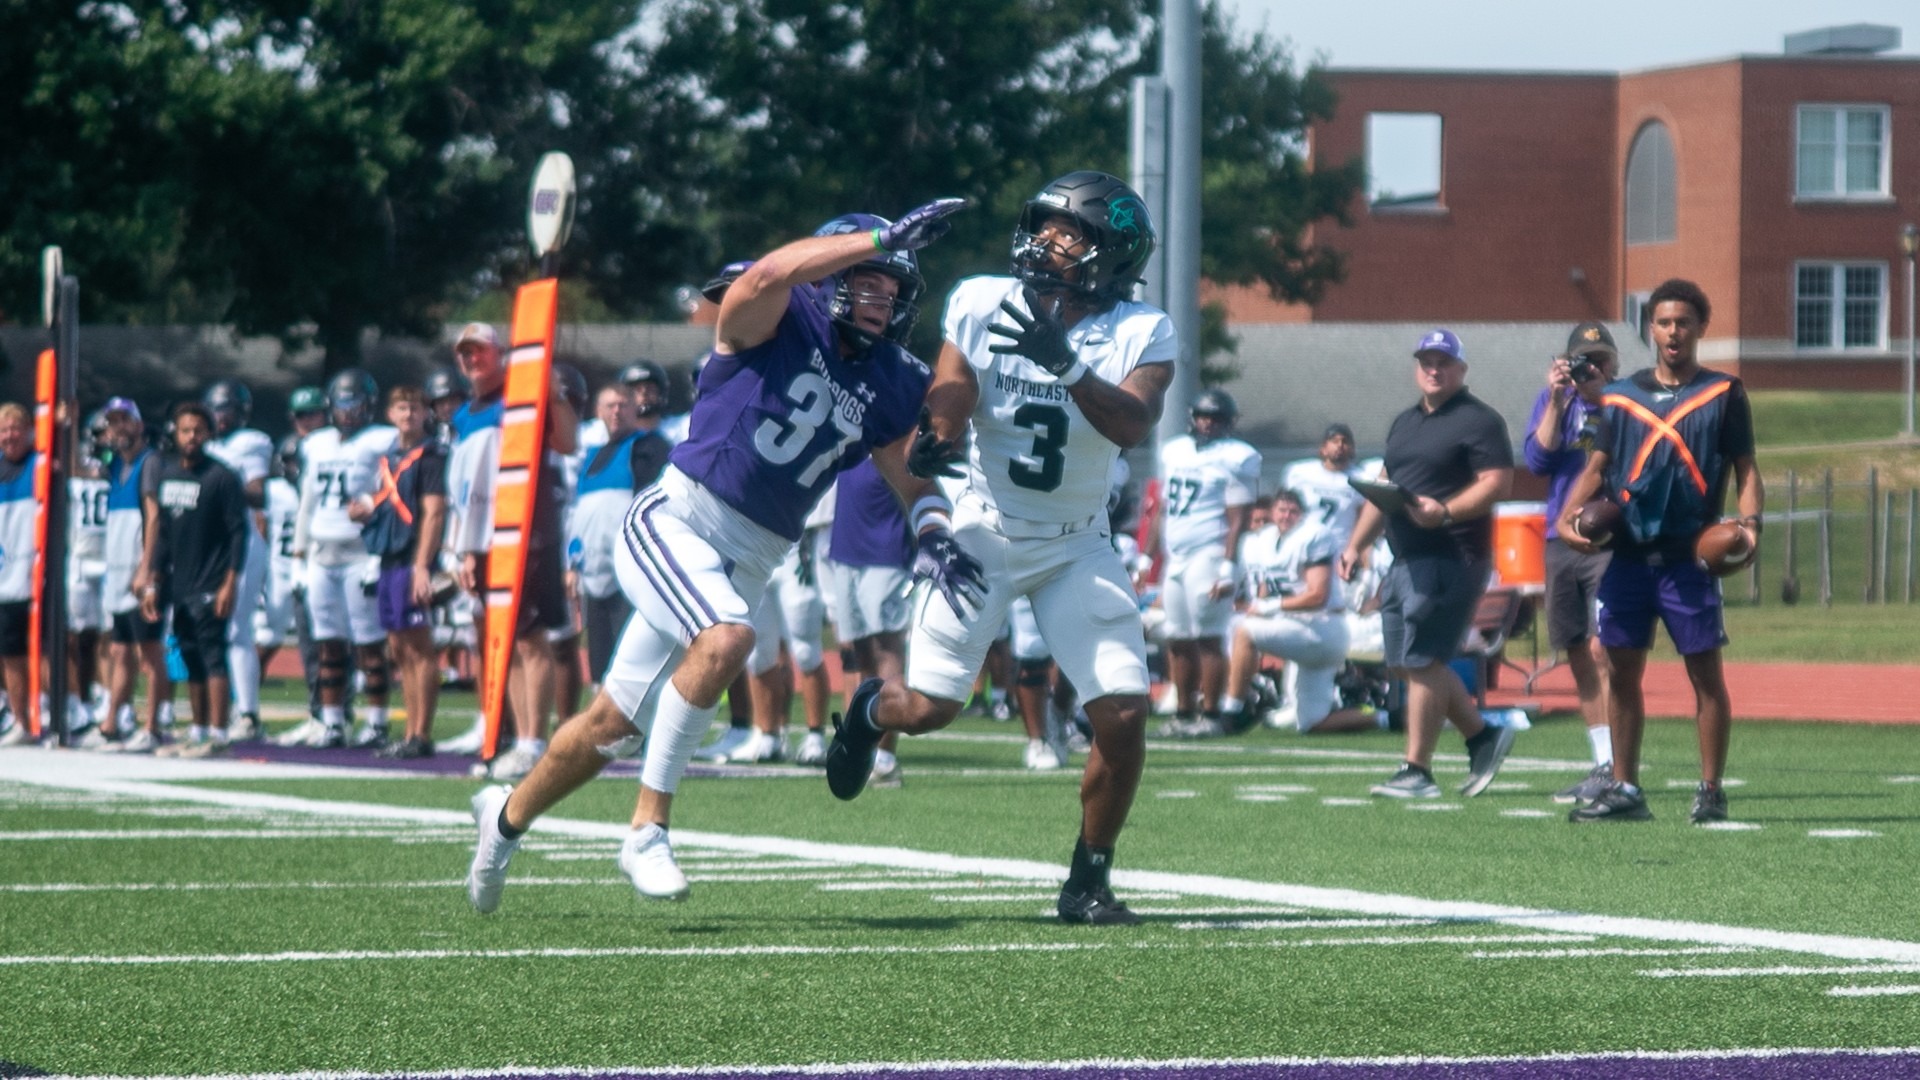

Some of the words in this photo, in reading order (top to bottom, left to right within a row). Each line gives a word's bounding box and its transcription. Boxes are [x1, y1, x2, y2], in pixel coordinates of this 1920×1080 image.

[754, 372, 863, 489] 37
[1008, 402, 1070, 493] 3
[317, 470, 350, 508] 71
[1168, 477, 1203, 517] 97
